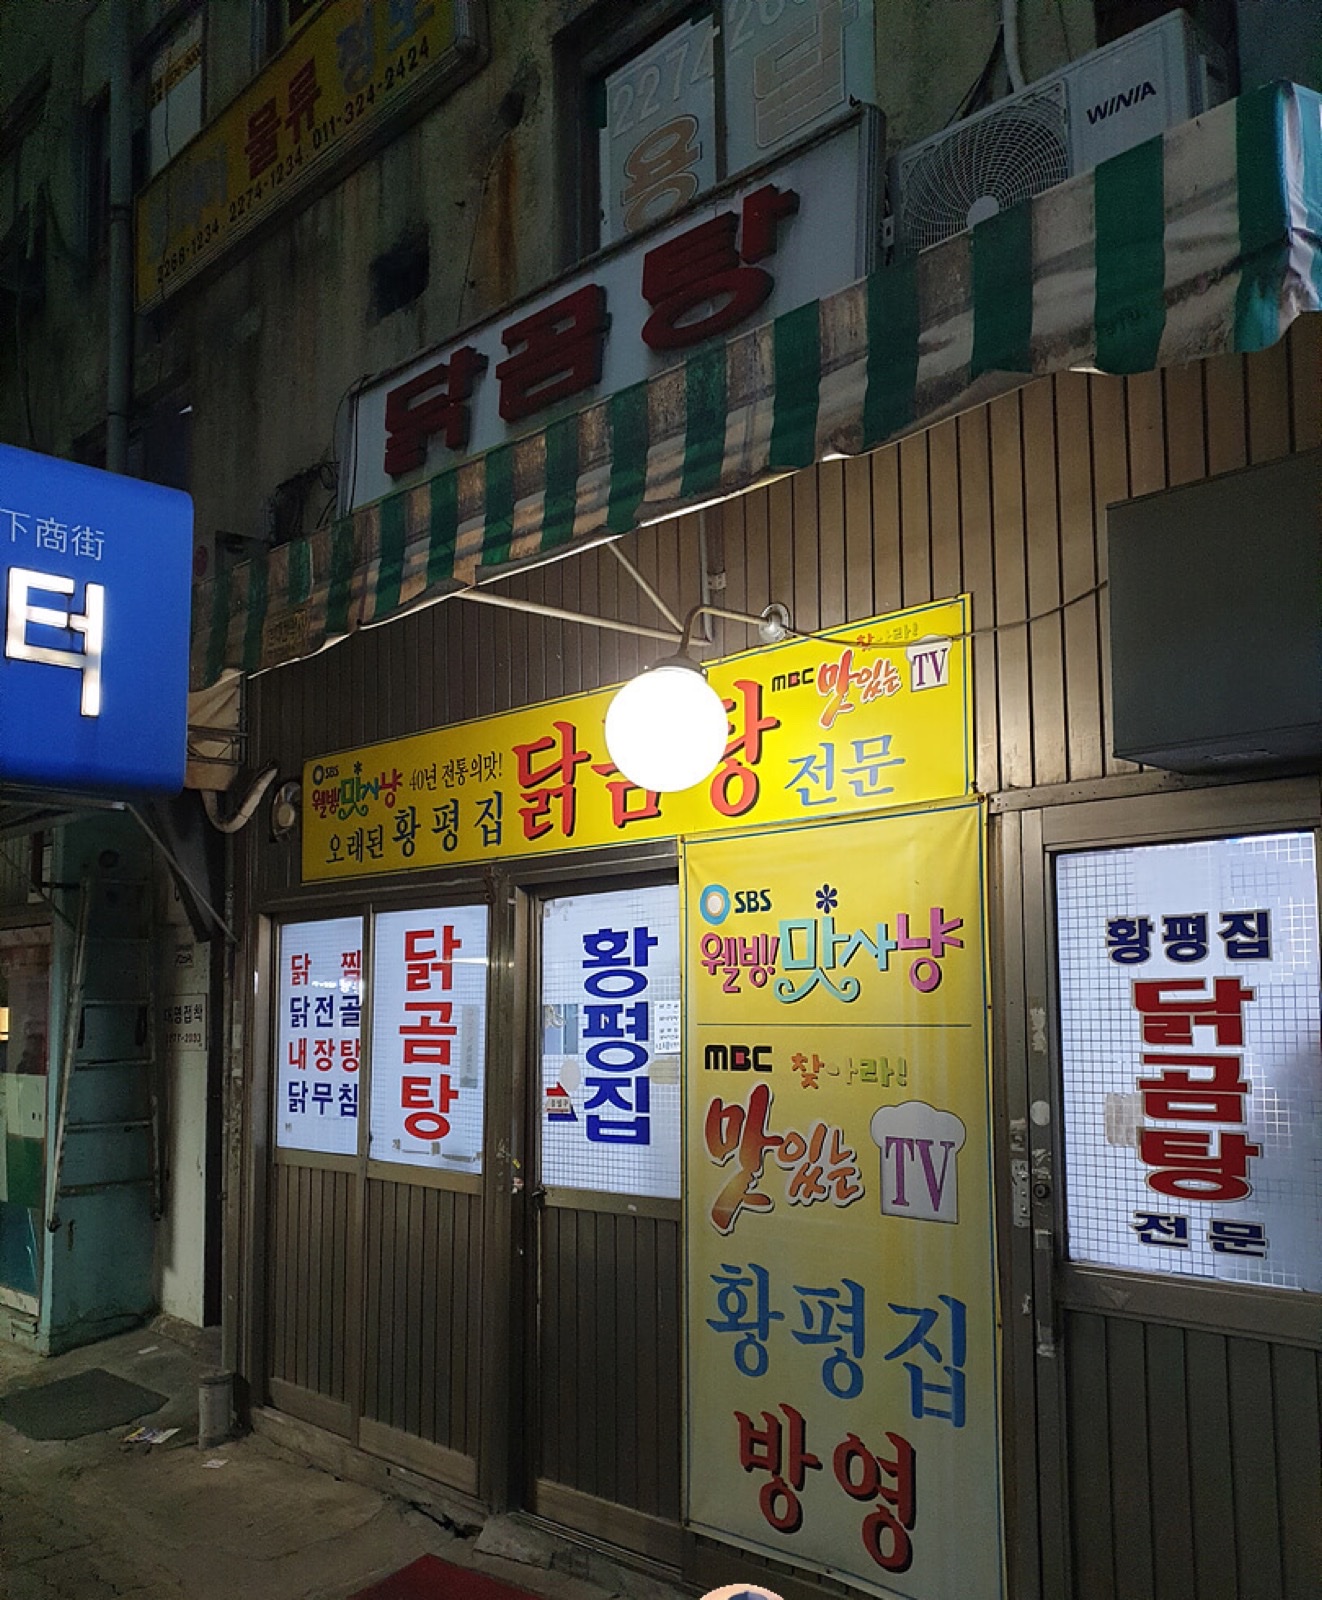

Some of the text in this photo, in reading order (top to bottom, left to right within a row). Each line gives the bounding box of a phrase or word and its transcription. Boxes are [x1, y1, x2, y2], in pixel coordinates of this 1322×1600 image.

[1086, 81, 1156, 124] WINIA
[0, 508, 105, 561] 下商街
[5, 566, 105, 717] 터
[912, 646, 948, 688] TV
[772, 668, 814, 693] MBC
[409, 763, 437, 791] 40년
[784, 734, 906, 807] 전문
[325, 790, 503, 864] 오래된 황평집
[734, 889, 772, 914] SBS
[1105, 909, 1272, 965] 황평집
[290, 995, 361, 1028] 닭전골
[399, 925, 462, 1141] 닭곰탕
[582, 926, 658, 1146] 황평집
[288, 1037, 361, 1072] 내장탕
[704, 1044, 773, 1072] MBC
[288, 1080, 358, 1118] 닭무침
[1131, 976, 1263, 1203] 닭곰탕
[704, 1083, 863, 1232] 맛있는
[885, 1136, 955, 1212] TV
[1131, 1209, 1268, 1259] 전문
[706, 1263, 967, 1428] 황평집
[734, 1403, 916, 1574] 방영
